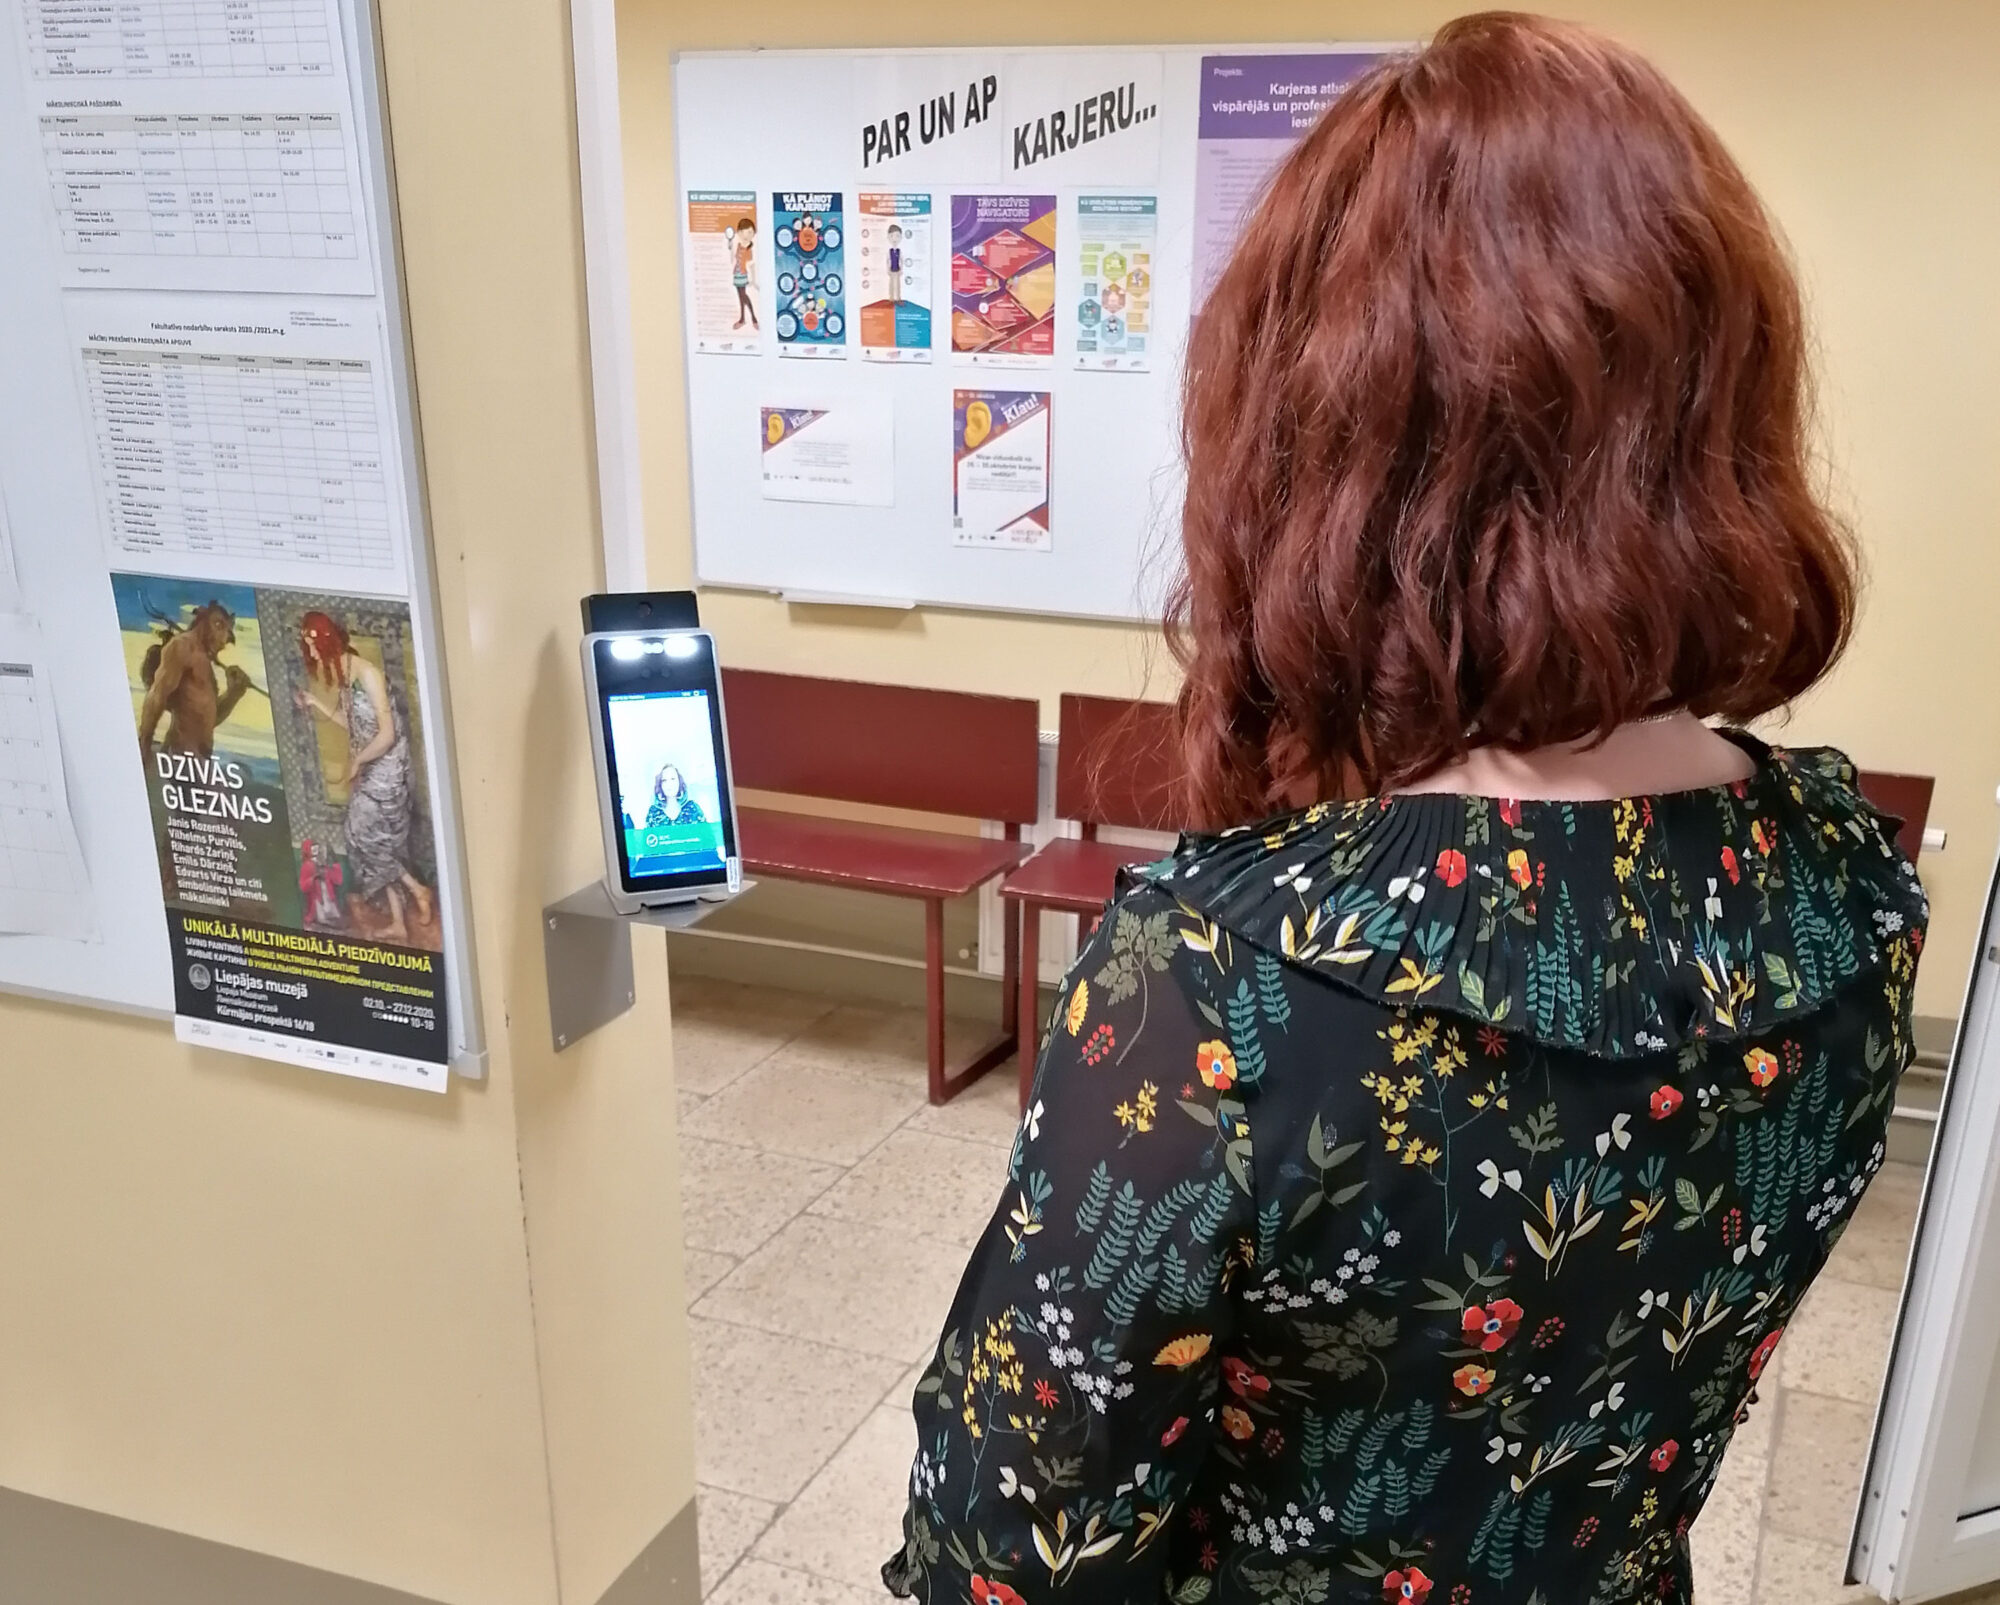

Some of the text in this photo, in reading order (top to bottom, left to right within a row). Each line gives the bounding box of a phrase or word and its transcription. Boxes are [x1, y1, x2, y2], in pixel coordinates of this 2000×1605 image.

[1269, 83, 1318, 98] Karjeras
[1212, 100, 1270, 114] vispārējās
[1272, 102, 1288, 112] un
[863, 75, 997, 168] PAR UN AP
[1013, 82, 1157, 170] KARJERU...
[783, 192, 833, 204] KĀ PLĀNOT
[976, 197, 1030, 208] TAVS DZĪVES
[784, 203, 831, 212] KARJERU?
[976, 208, 1030, 218] NAVIGATORS
[1003, 393, 1039, 423] Klau!
[156, 752, 244, 789] DZĪVĀS
[162, 784, 273, 824] GLEZNAS
[167, 816, 238, 837] Janis Rozentāls,
[168, 829, 207, 844] Vilhelms
[171, 841, 205, 855] Rihards
[175, 866, 262, 889] Edvarts Virza un citi
[229, 886, 268, 902] laikmeta
[183, 917, 433, 973] UNIKĀLĀ MULTIMEDIĀLĀ PIEDZĪVOJUMĀ
[215, 968, 308, 999] Liepājas muzejā
